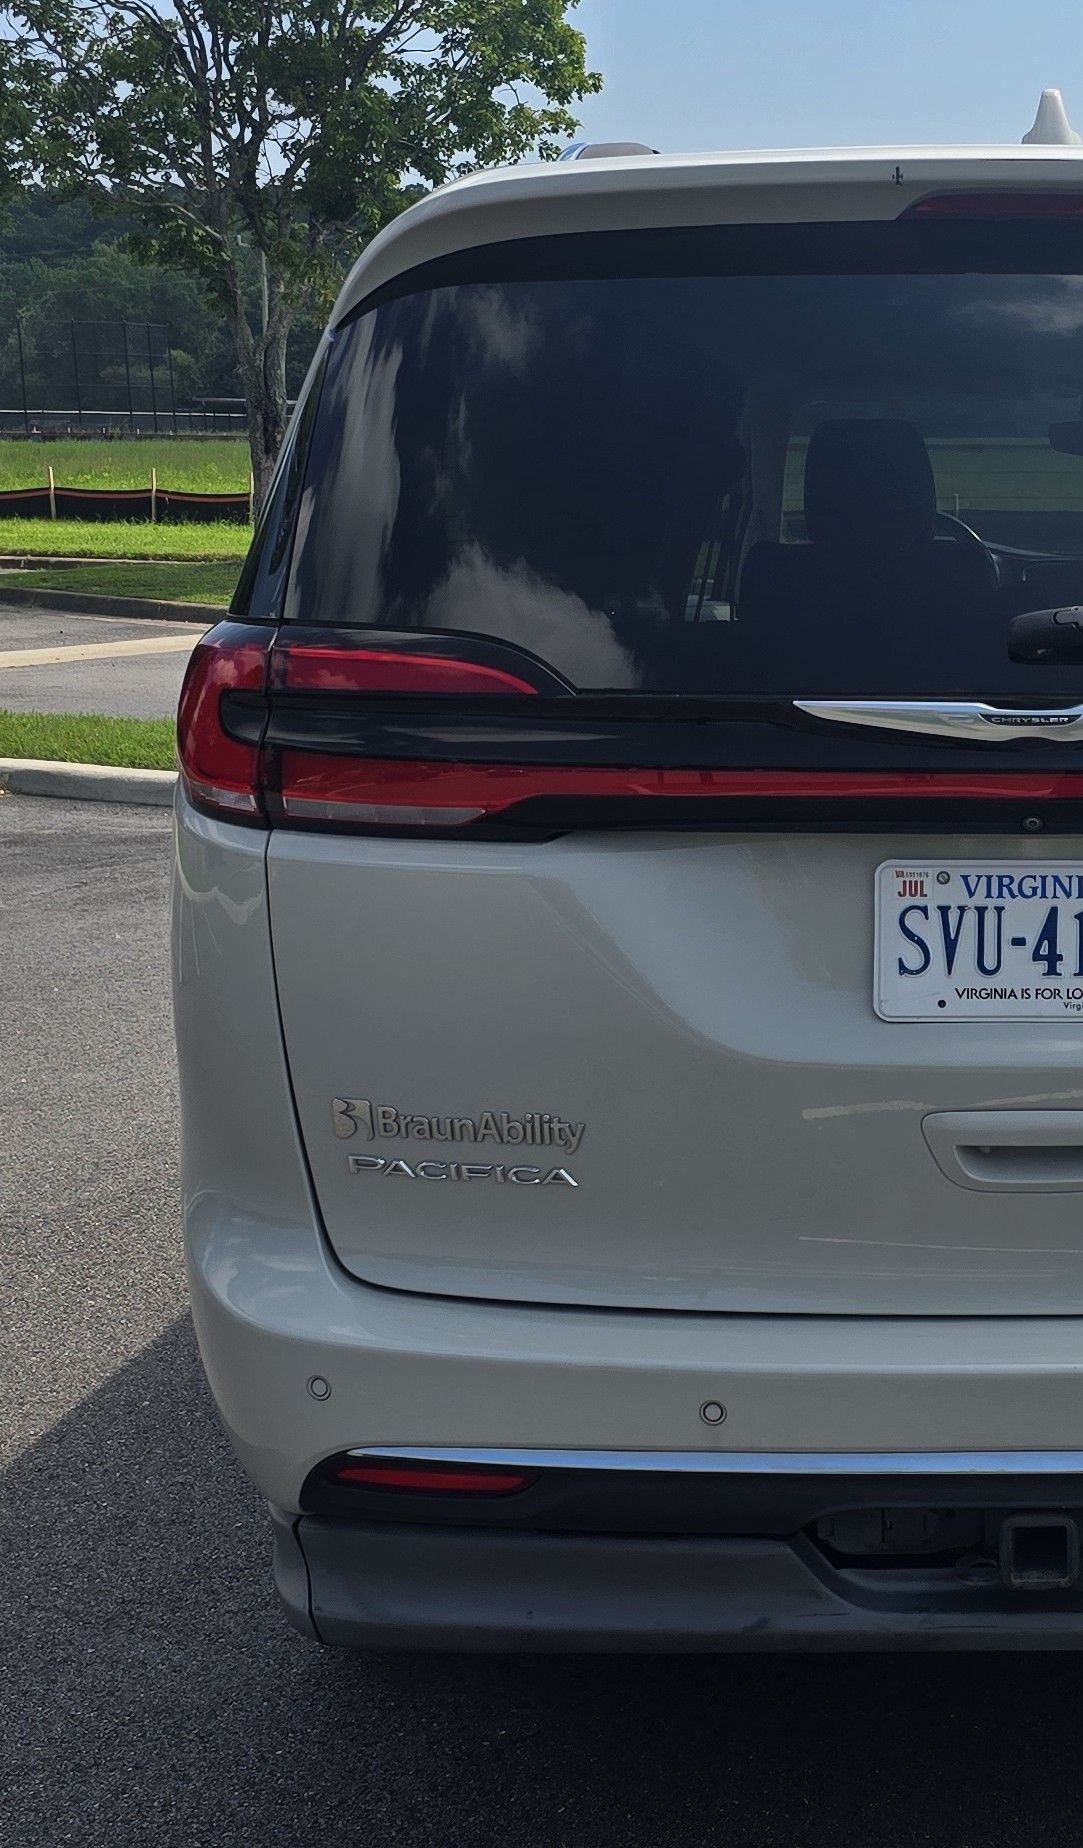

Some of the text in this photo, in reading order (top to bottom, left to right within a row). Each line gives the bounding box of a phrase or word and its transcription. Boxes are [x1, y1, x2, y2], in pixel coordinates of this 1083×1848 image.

[897, 880, 928, 897] JUL
[954, 987, 1018, 1000] VIRGINIA
[1020, 987, 1032, 1000] IS
[1035, 987, 1064, 1000] FOR
[376, 1105, 586, 1155] BraunAbility
[348, 1154, 580, 1188] PACIFICA
